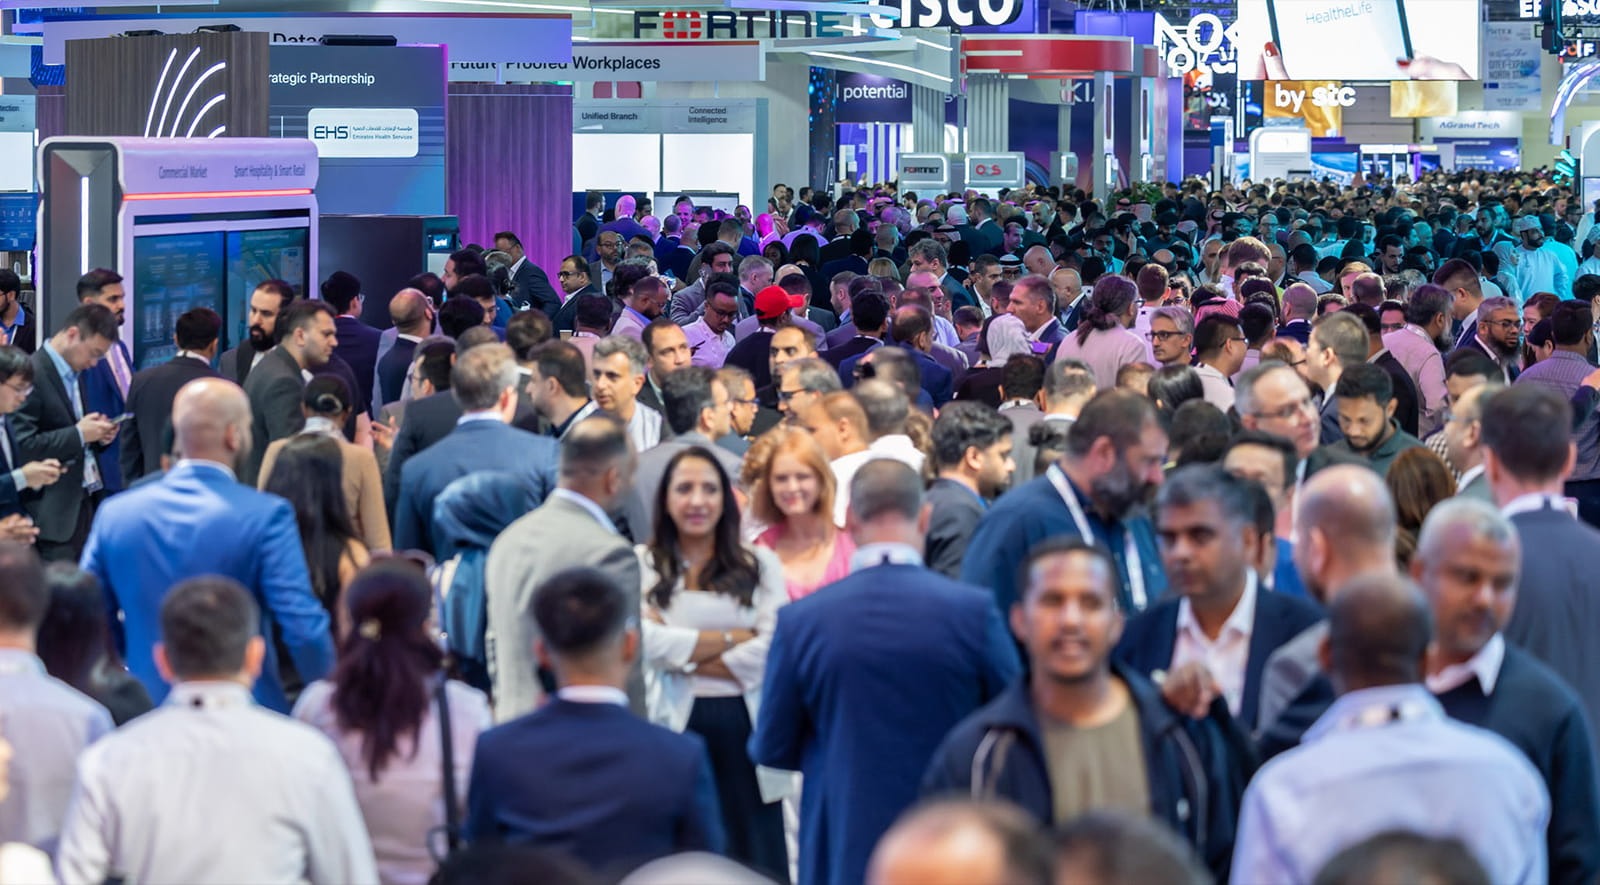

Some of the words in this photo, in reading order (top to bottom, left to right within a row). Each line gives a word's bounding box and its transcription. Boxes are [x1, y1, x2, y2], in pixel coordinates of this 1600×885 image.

[1305, 2, 1373, 24] HealtheLife
[633, 11, 844, 38] FORTINE
[572, 56, 661, 72] Workplaces
[269, 72, 307, 86] rategic
[310, 72, 375, 86] Partnership
[843, 83, 907, 102] potential
[1275, 83, 1306, 113] by
[1311, 83, 1356, 107] stc
[581, 112, 609, 120] Unified
[611, 112, 638, 120] Branch
[689, 106, 727, 114] Connected
[688, 115, 727, 124] Intelligence
[314, 126, 348, 139] EHS
